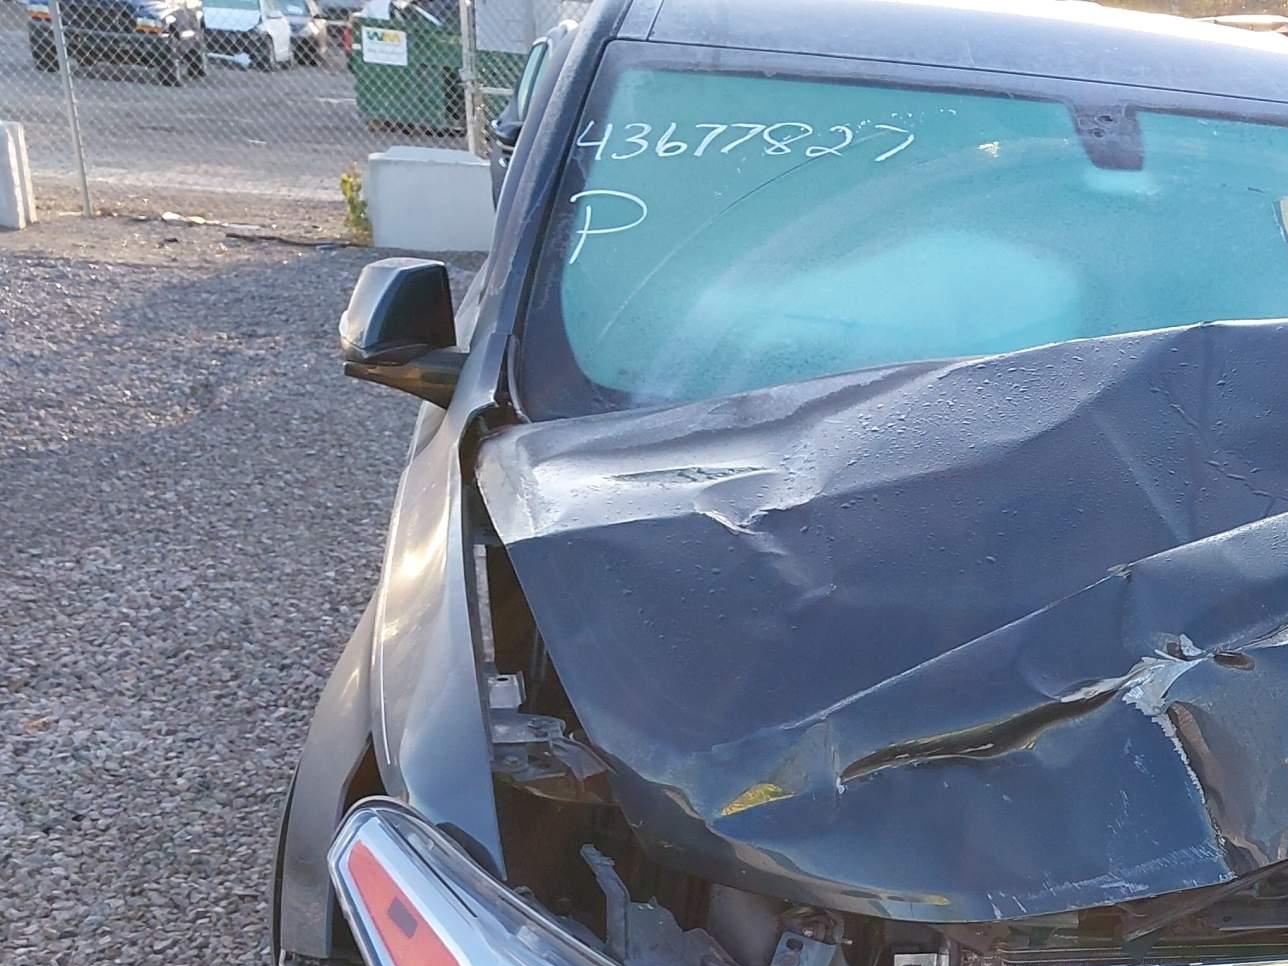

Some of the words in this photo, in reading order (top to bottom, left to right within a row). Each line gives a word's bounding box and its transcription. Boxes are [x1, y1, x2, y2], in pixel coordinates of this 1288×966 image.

[366, 31, 401, 43] WM
[575, 119, 915, 162] 43677827
[569, 189, 648, 265] P
